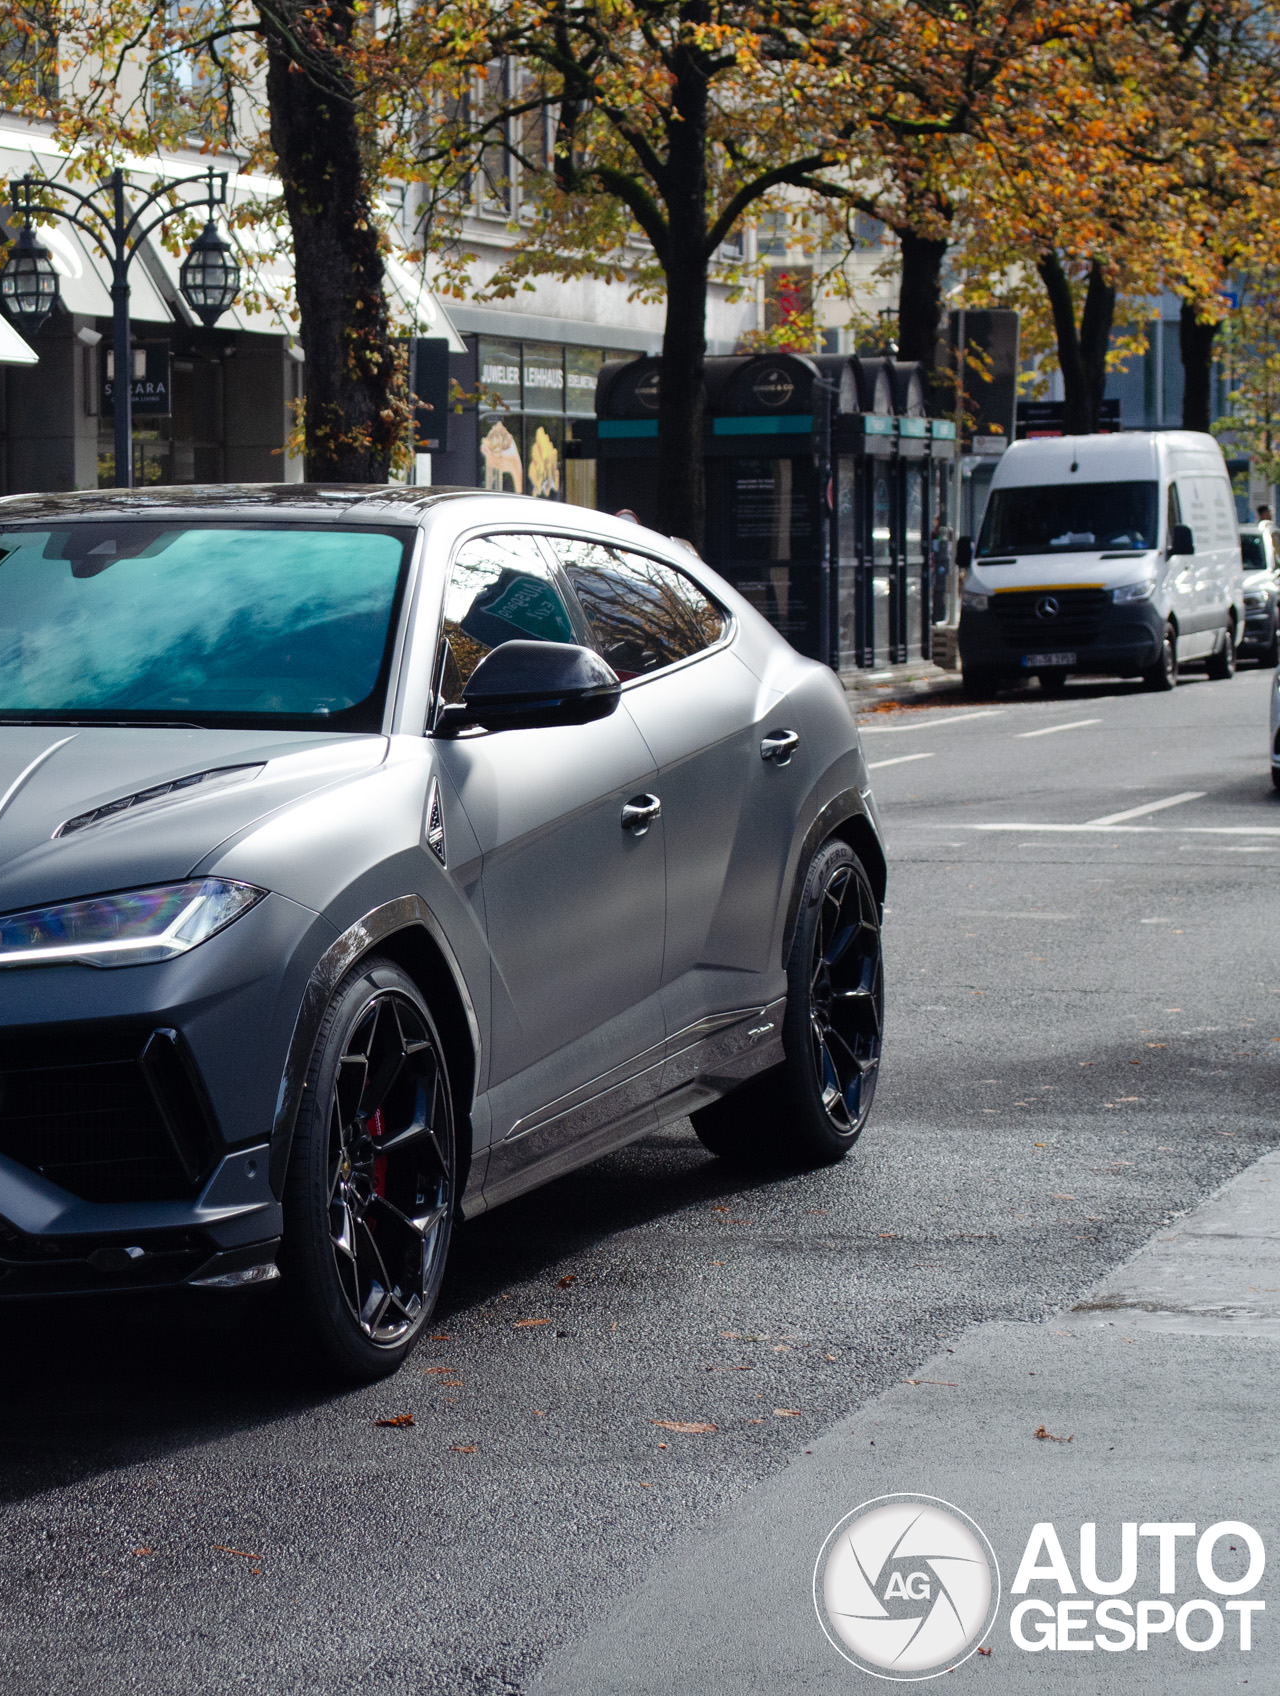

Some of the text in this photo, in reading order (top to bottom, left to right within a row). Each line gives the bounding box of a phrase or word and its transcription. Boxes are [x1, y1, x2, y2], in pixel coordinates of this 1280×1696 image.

[481, 364, 520, 385] JUWELIER
[524, 367, 564, 389] LEIHHAUS
[105, 382, 166, 395] SARA
